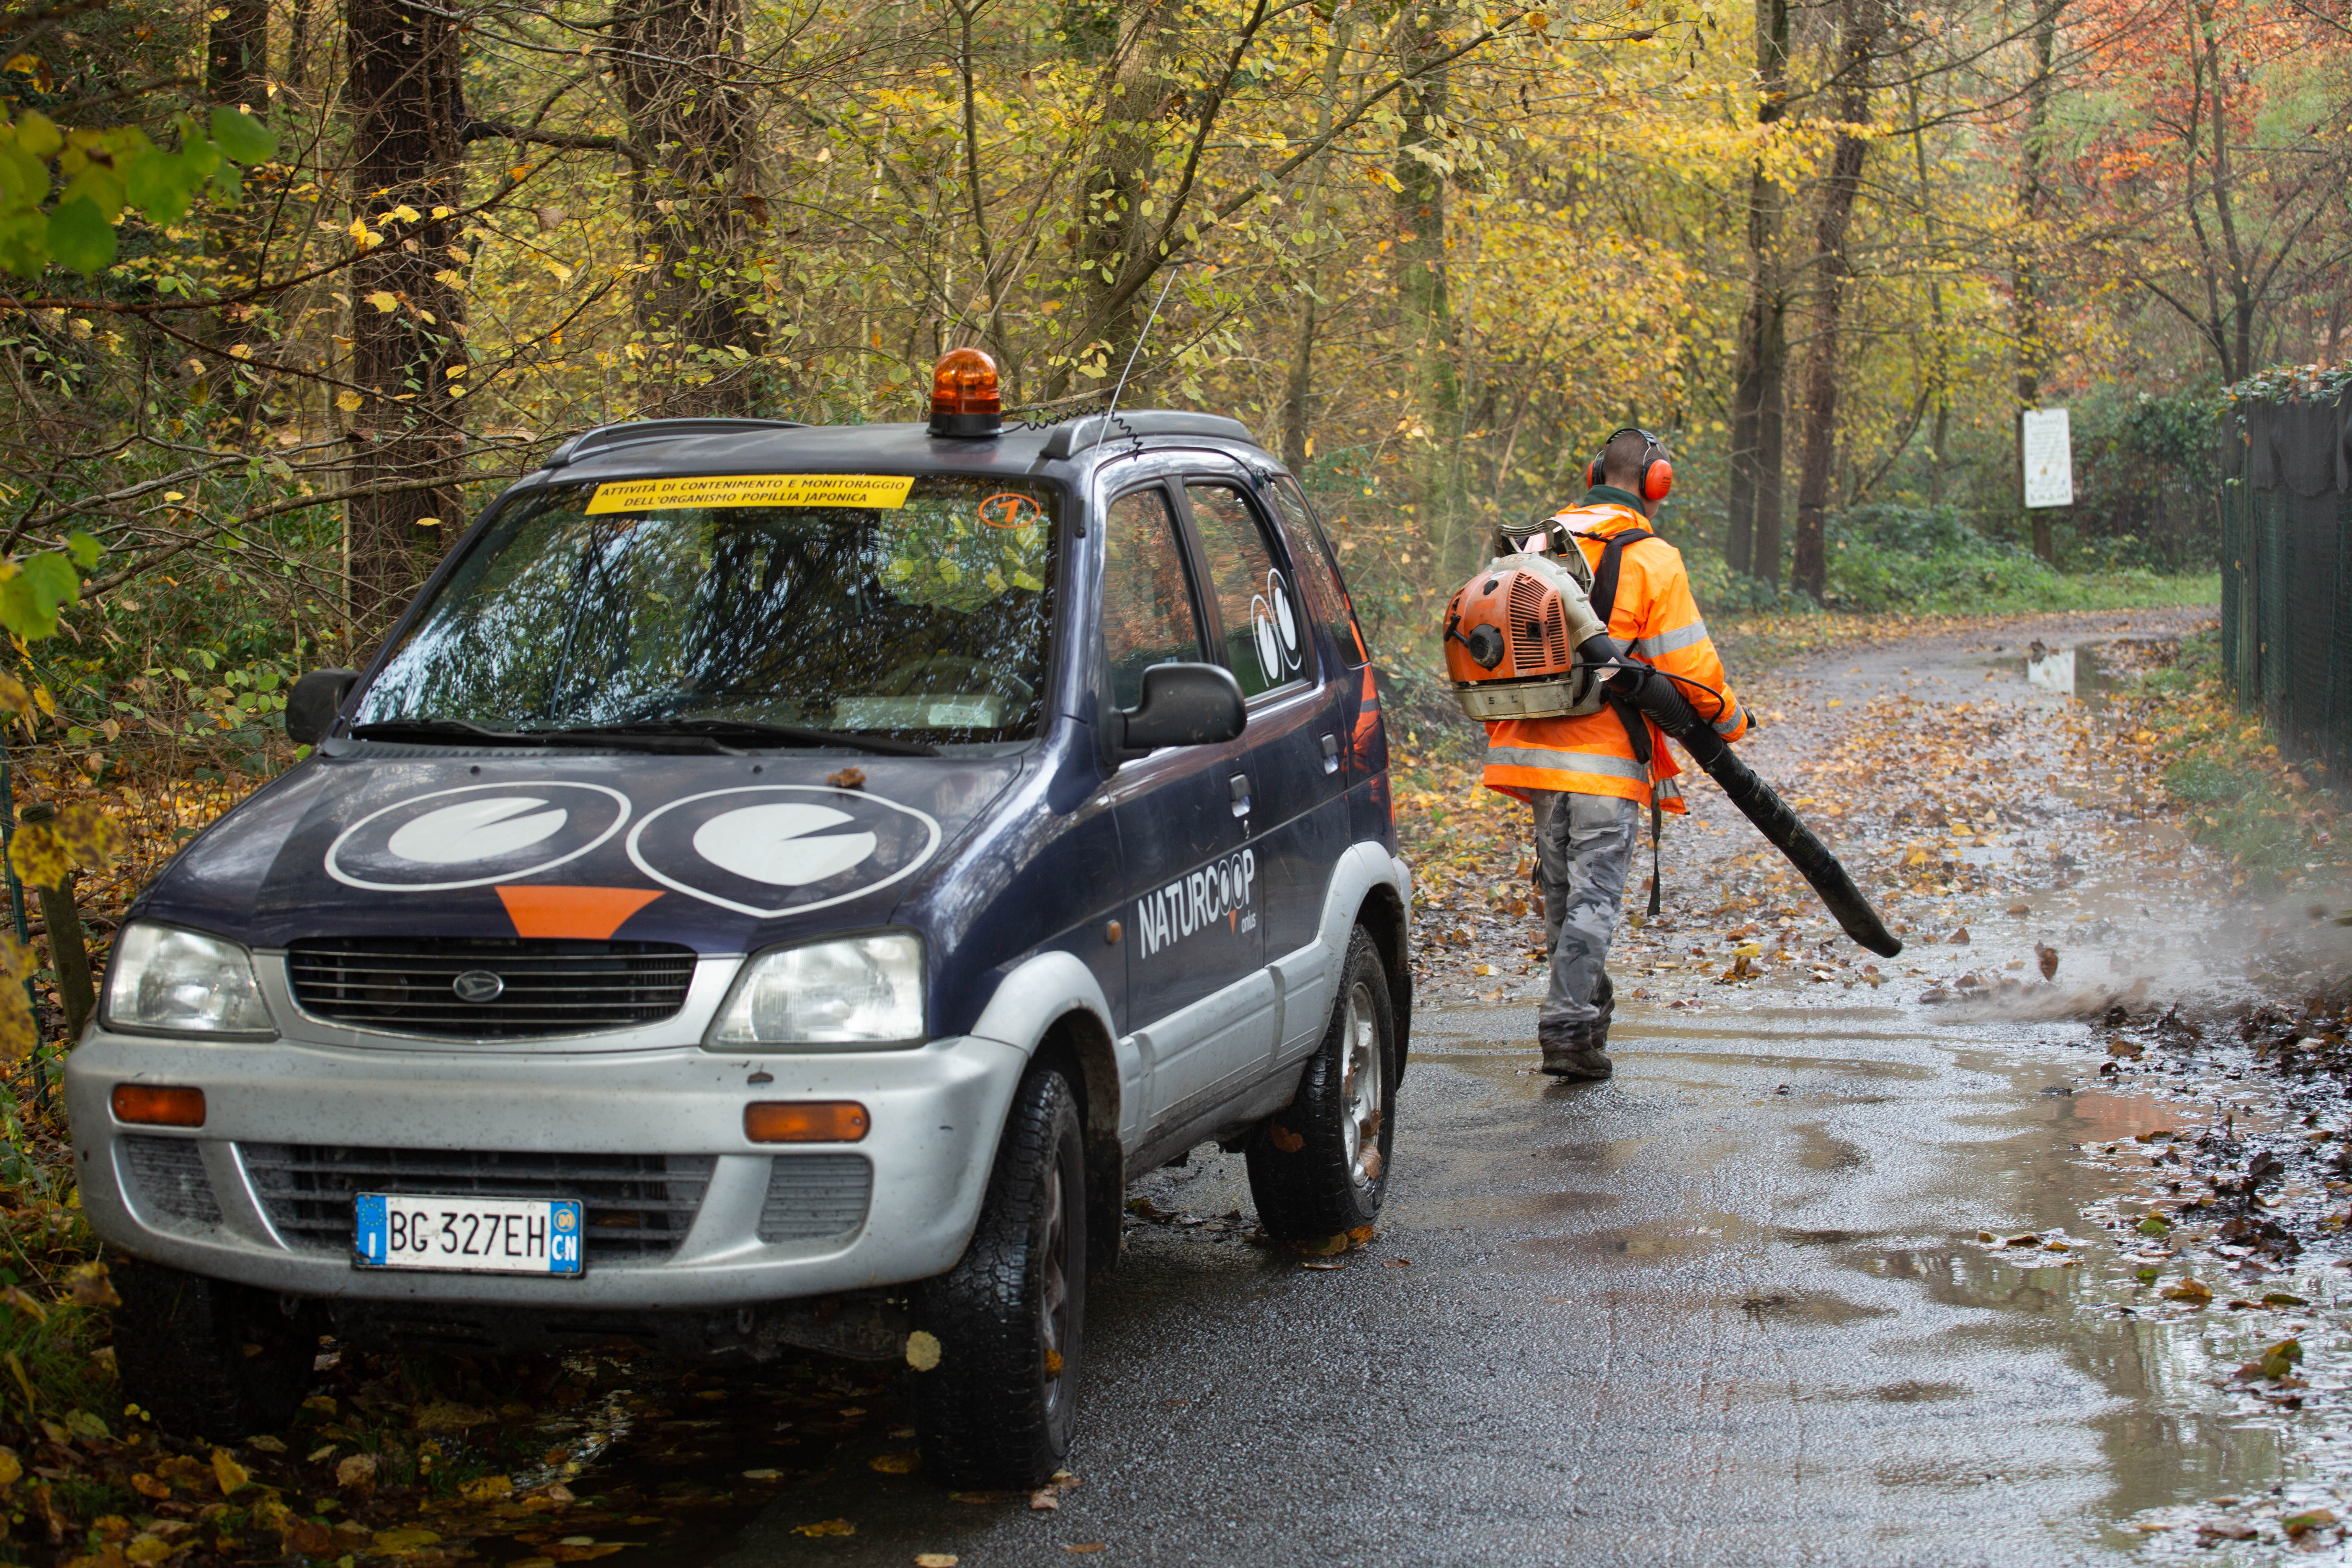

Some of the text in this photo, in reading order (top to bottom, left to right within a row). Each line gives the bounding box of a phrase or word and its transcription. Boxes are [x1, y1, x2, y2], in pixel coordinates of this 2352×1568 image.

[601, 483, 656, 496] ATTIVITÀ
[681, 480, 782, 490] CONTENIMENTO
[801, 480, 905, 490] MONITORAGGIO
[624, 493, 866, 507] DELL'ORGANISMO POPILLIA JAPONICA
[996, 499, 1020, 523] 1
[1138, 849, 1254, 960] NATURCOOP
[1242, 909, 1256, 934] onlus
[552, 1234, 577, 1261] CN
